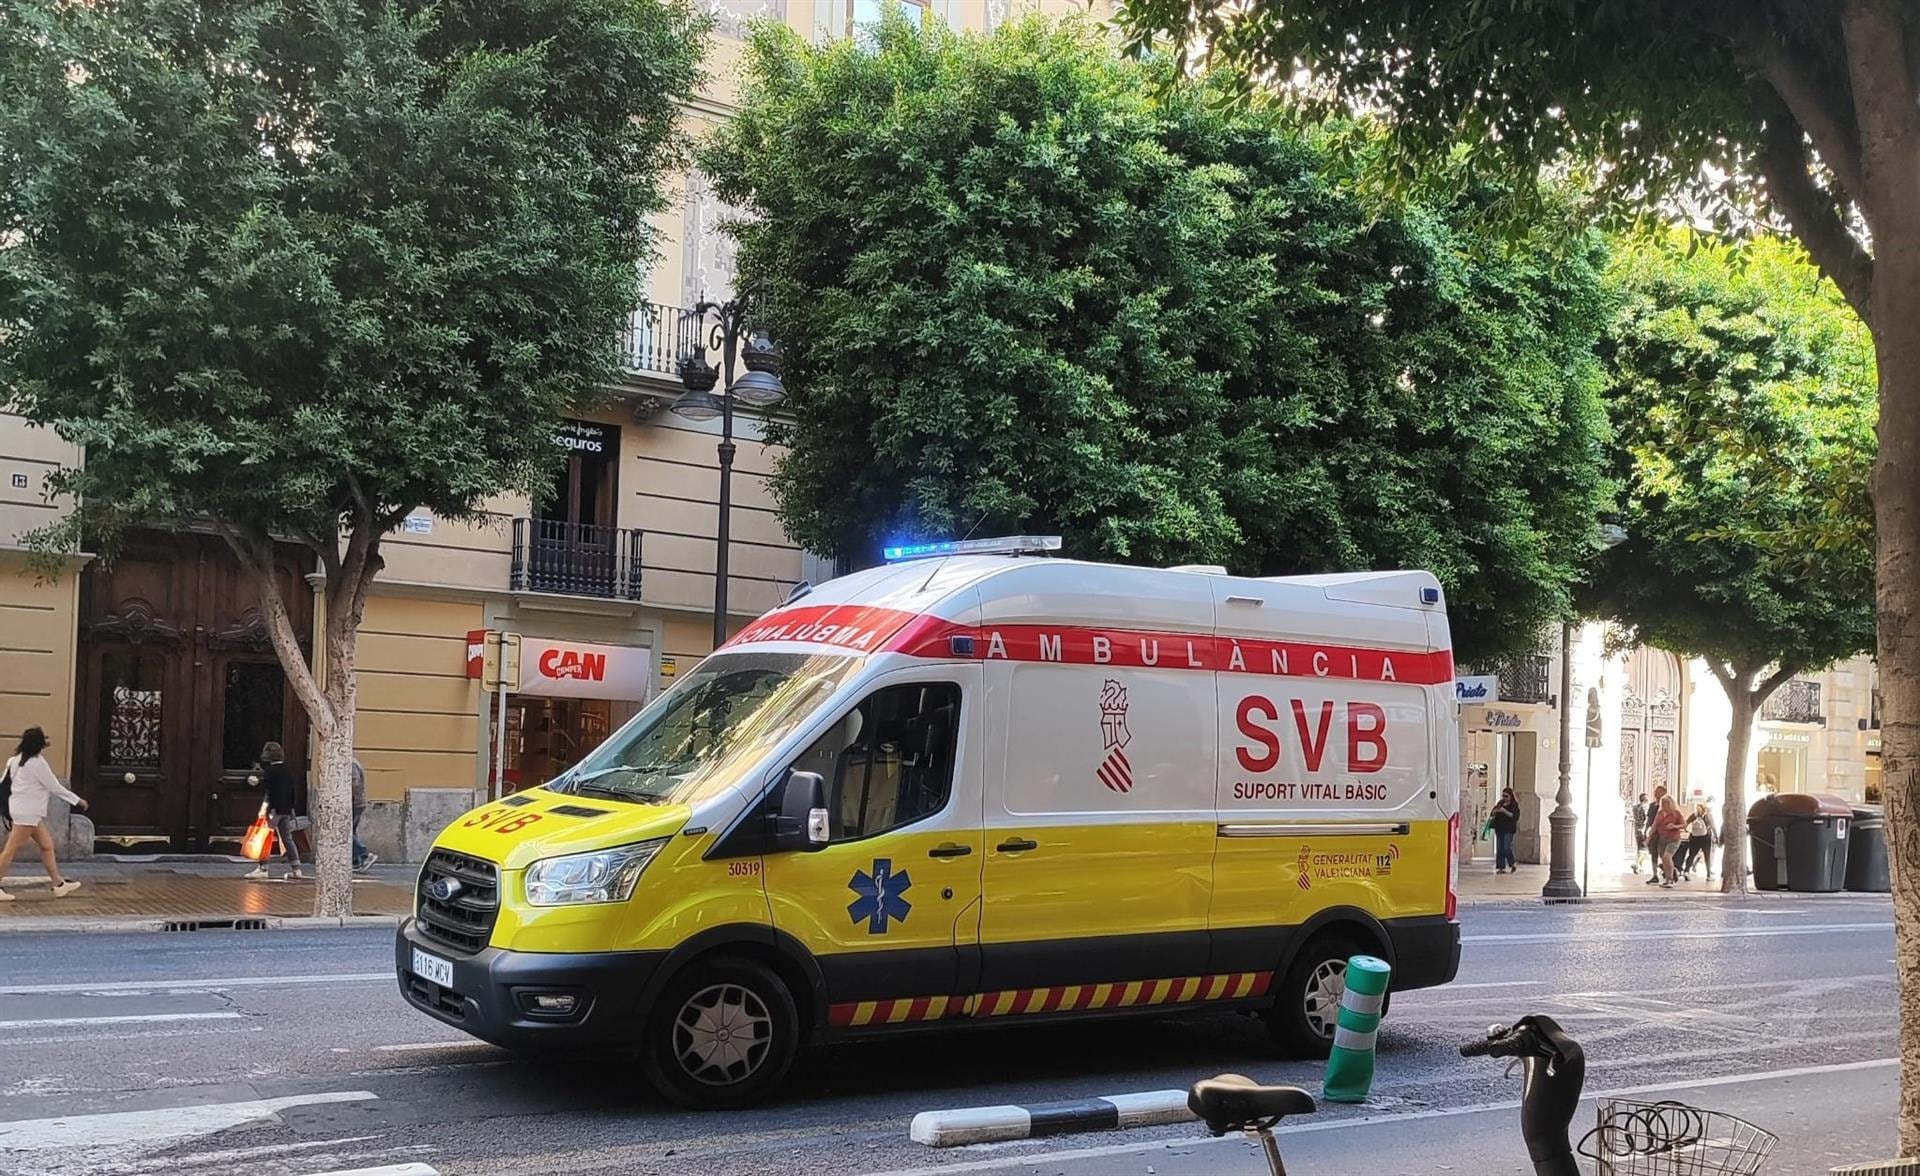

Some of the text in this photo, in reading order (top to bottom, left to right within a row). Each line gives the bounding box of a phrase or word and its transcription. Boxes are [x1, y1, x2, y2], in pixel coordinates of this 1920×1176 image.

[550, 434, 602, 452] seguros
[539, 649, 606, 681] CAN
[986, 630, 1397, 681] AMBULÀNCIA
[1235, 695, 1388, 773] SVB
[1234, 779, 1388, 800] SUPORT VITAL BÀSIC
[463, 808, 543, 834] SVB
[1312, 853, 1373, 865] GENERALITAT
[1376, 854, 1391, 867] 112
[728, 862, 760, 876] 30319
[1315, 866, 1372, 878] VALENCIANA
